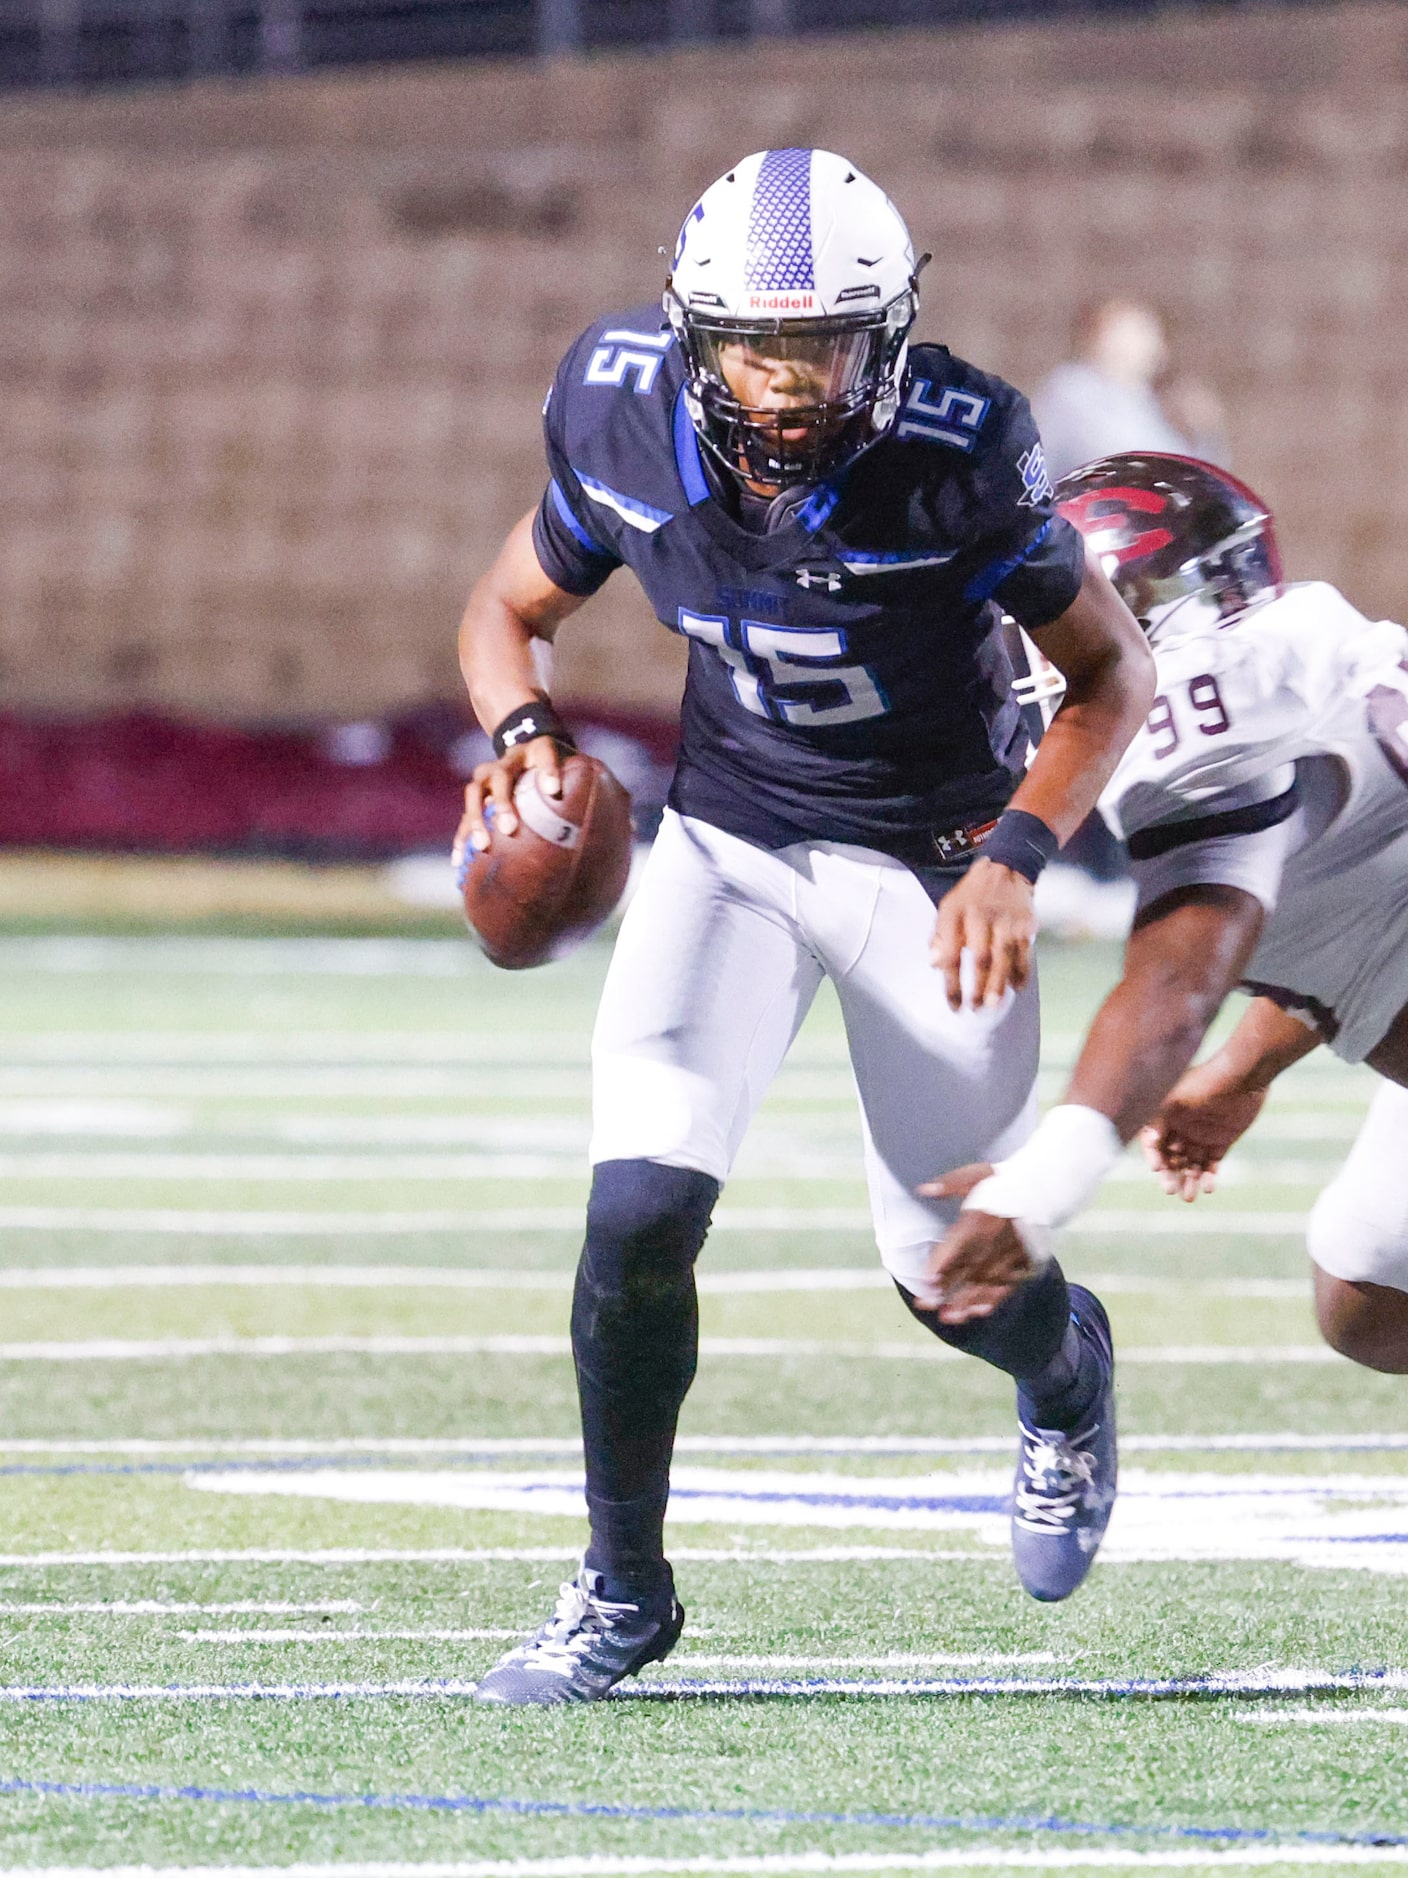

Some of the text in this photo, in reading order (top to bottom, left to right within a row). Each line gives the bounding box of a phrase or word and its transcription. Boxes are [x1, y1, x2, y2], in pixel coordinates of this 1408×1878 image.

[750, 295, 813, 308] Riddell
[583, 329, 677, 395] 15
[896, 377, 992, 453] 15
[678, 606, 892, 719] 15
[1147, 673, 1230, 761] 99
